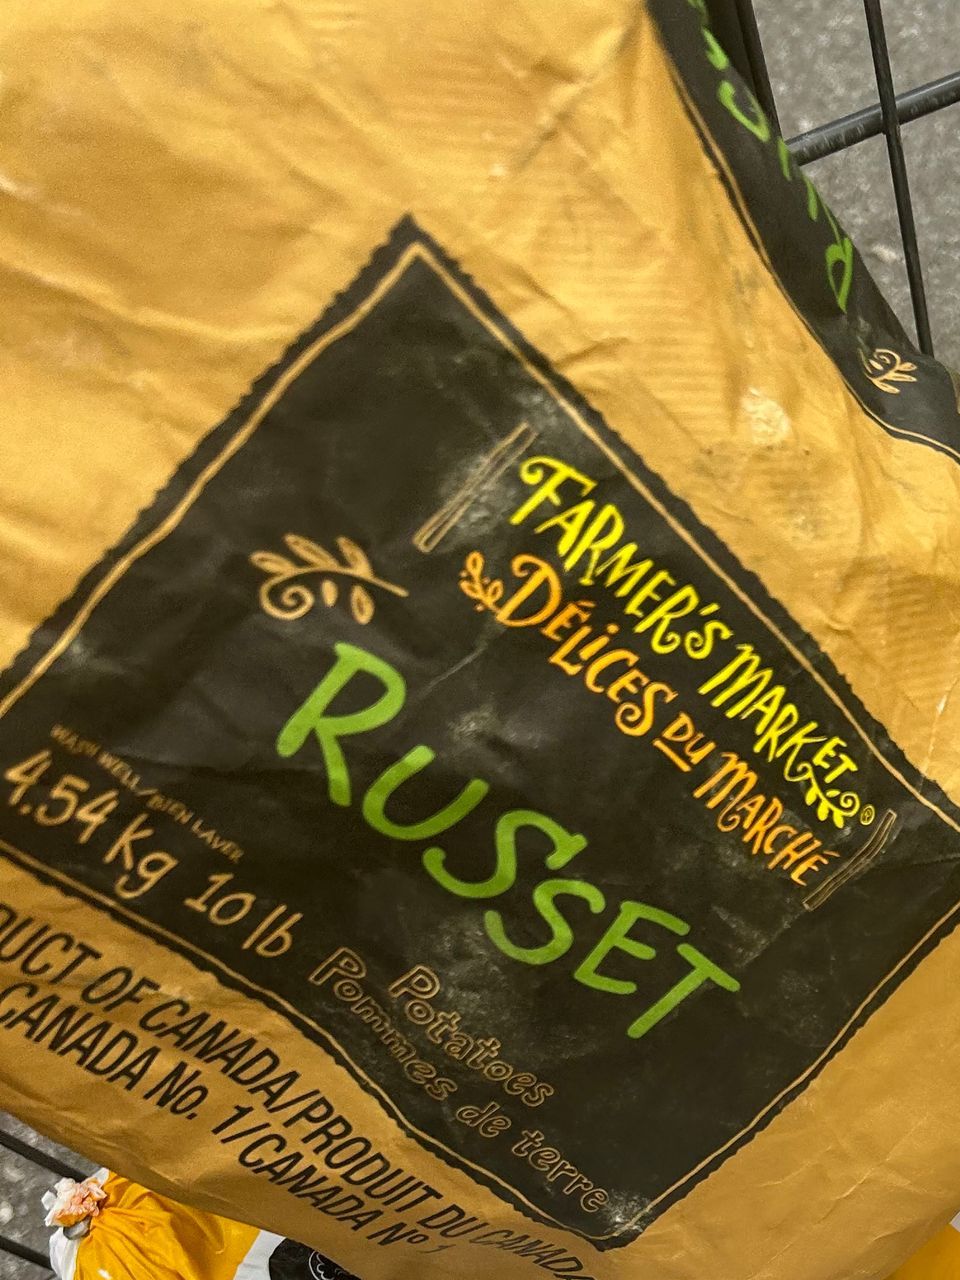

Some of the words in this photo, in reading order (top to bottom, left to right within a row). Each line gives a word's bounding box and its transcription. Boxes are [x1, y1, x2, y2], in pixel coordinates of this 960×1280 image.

[496, 554, 677, 737] DÉLICES
[662, 712, 716, 766] DU
[693, 751, 840, 886] MARCHÉ
[510, 456, 733, 659] FARMER'S
[698, 644, 858, 784] MARKET
[5, 751, 119, 844] 4.54
[184, 873, 256, 926] 10
[242, 904, 303, 959] lb
[275, 642, 741, 1039] RUSSET
[0, 981, 162, 1091] CANADA
[142, 1061, 209, 1120] No.
[211, 1103, 384, 1232] 1/CANADA
[81, 965, 160, 1014] OF
[139, 998, 444, 1212] CANADA/PRODUIT
[417, 1203, 479, 1239] DU
[308, 947, 458, 1101] Pommes
[456, 1102, 512, 1138] de
[512, 1128, 611, 1213] terre
[389, 965, 554, 1108] Potatoes
